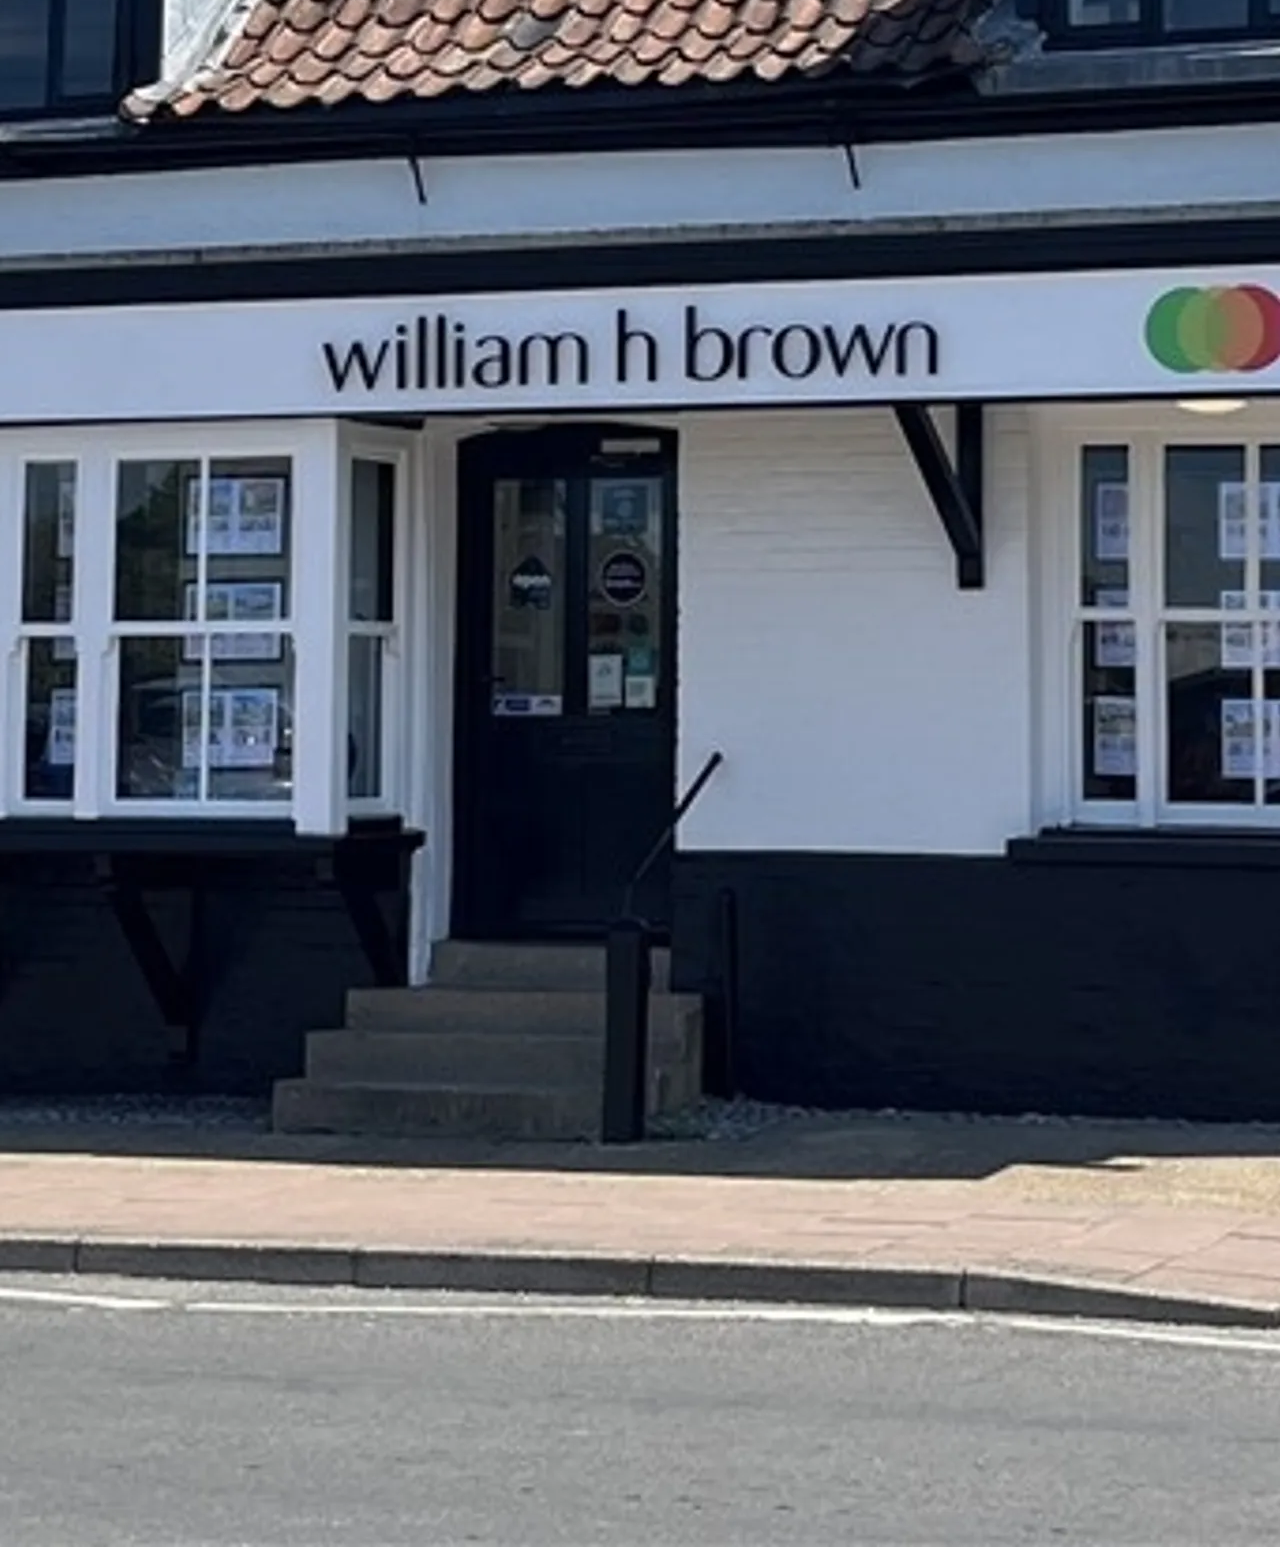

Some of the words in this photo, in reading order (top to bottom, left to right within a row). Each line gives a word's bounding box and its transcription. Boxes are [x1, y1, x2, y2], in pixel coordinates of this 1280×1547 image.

[322, 314, 590, 392] william
[616, 309, 658, 383] h
[684, 305, 939, 382] brown
